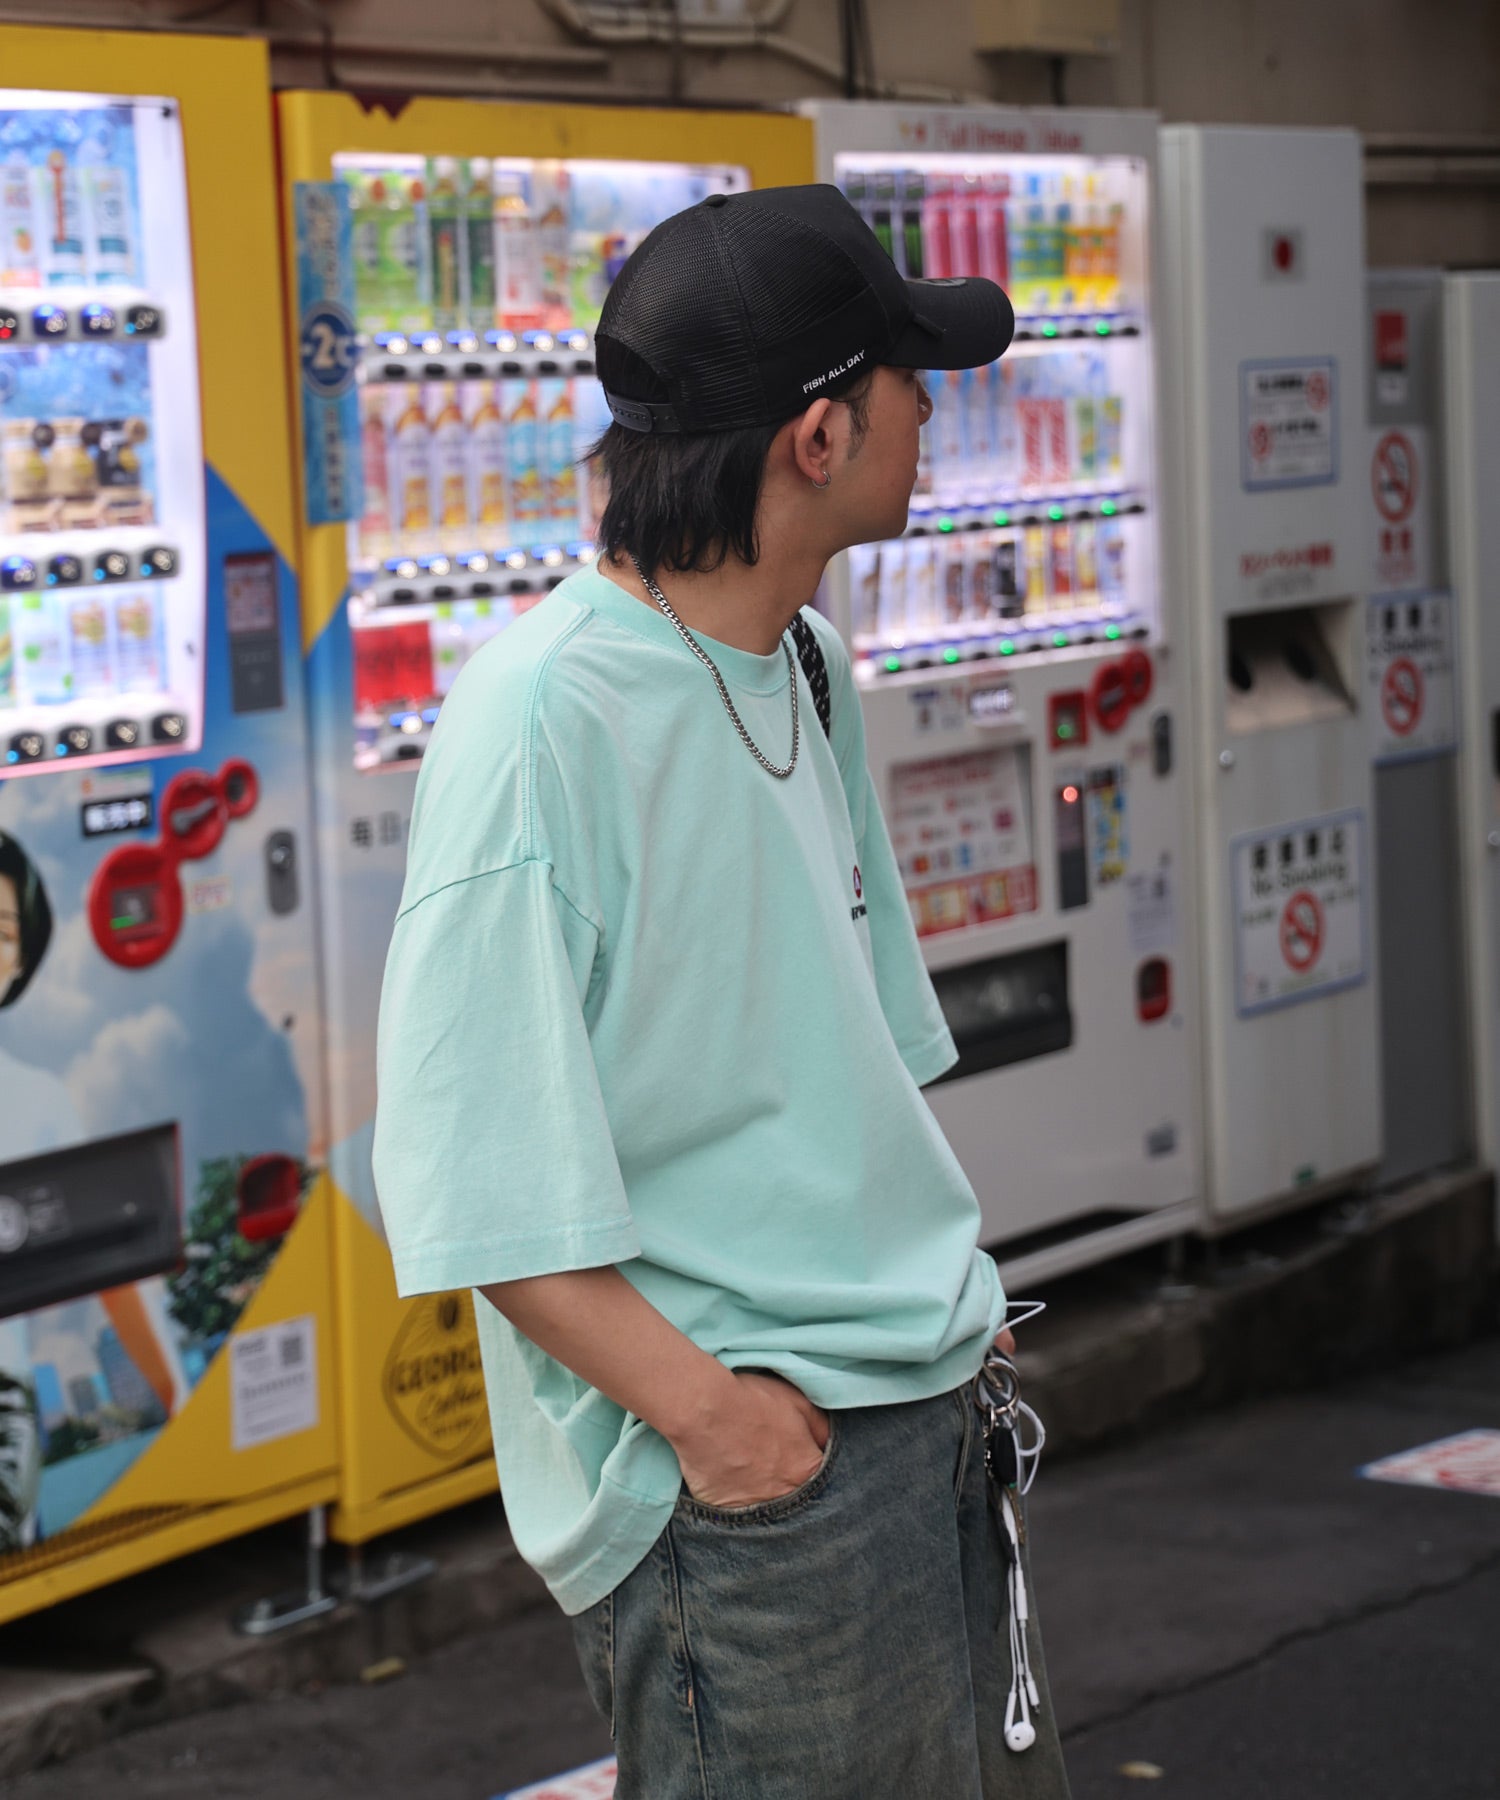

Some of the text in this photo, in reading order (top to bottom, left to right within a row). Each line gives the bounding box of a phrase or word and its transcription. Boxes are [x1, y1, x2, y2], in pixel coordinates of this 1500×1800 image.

[802, 349, 865, 394] FISH ALL DAY
